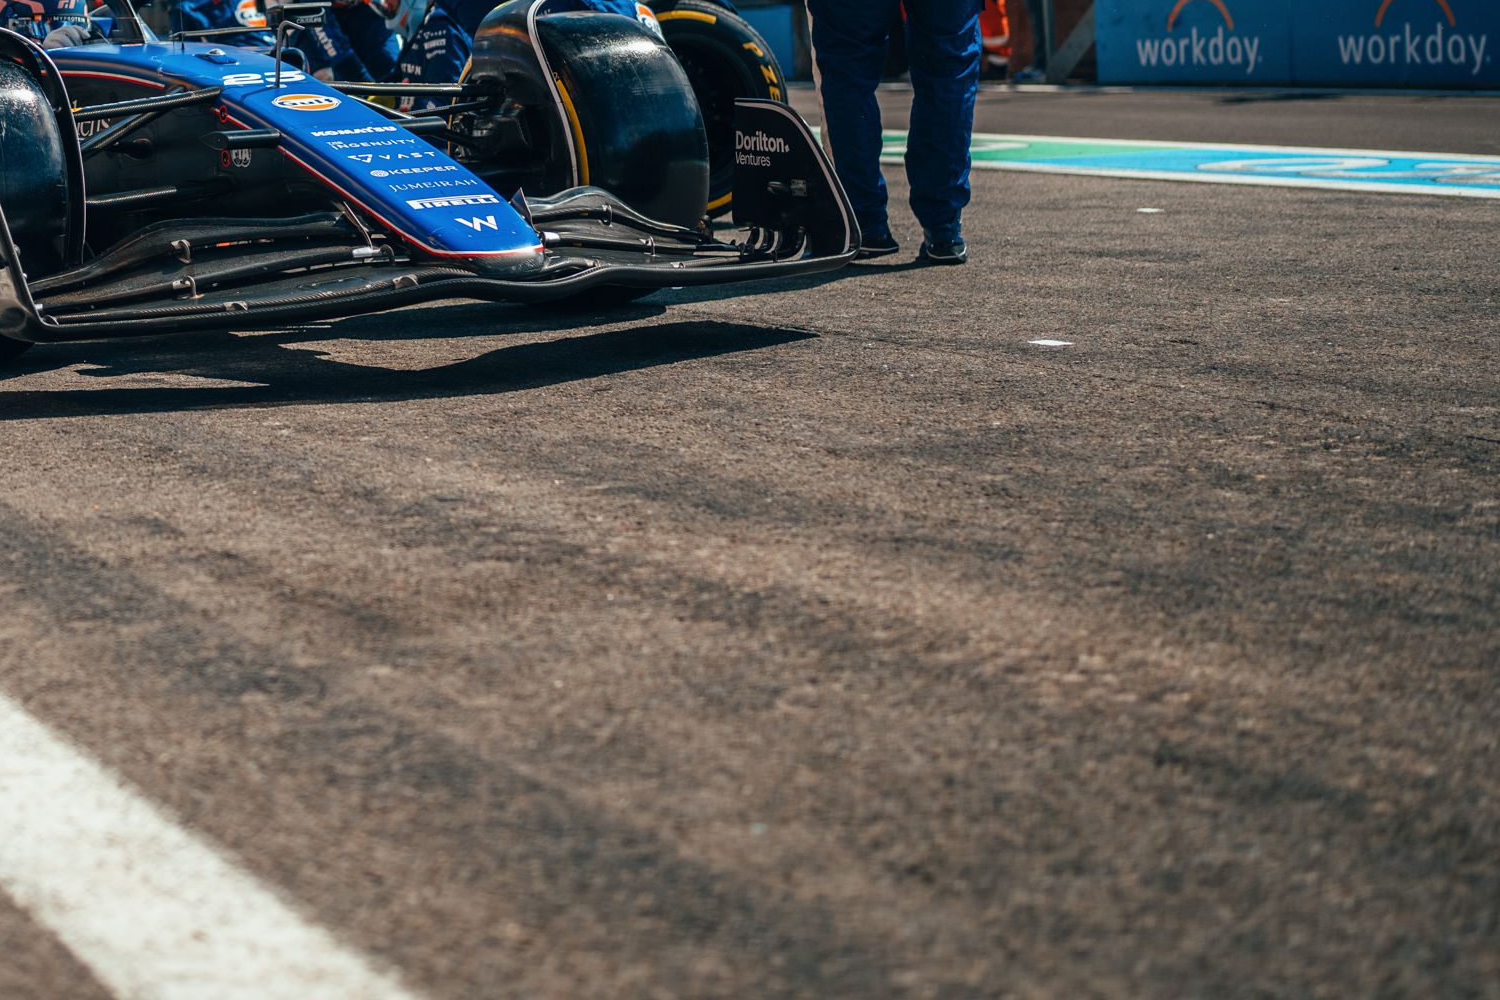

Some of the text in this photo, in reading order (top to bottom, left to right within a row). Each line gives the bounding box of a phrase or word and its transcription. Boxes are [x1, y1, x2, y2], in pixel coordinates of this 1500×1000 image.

[1136, 25, 1260, 74] workday
[1337, 21, 1488, 74] workday
[221, 70, 307, 89] 23
[279, 98, 334, 107] Gulf
[310, 126, 398, 137] KOMATSU
[331, 138, 417, 151] INGENUITY
[378, 151, 437, 160] VAST
[734, 151, 772, 167] Ventures
[390, 165, 459, 176] KEEPER
[388, 178, 478, 193] JUMEIRAH
[405, 194, 501, 211] PIRELLI
